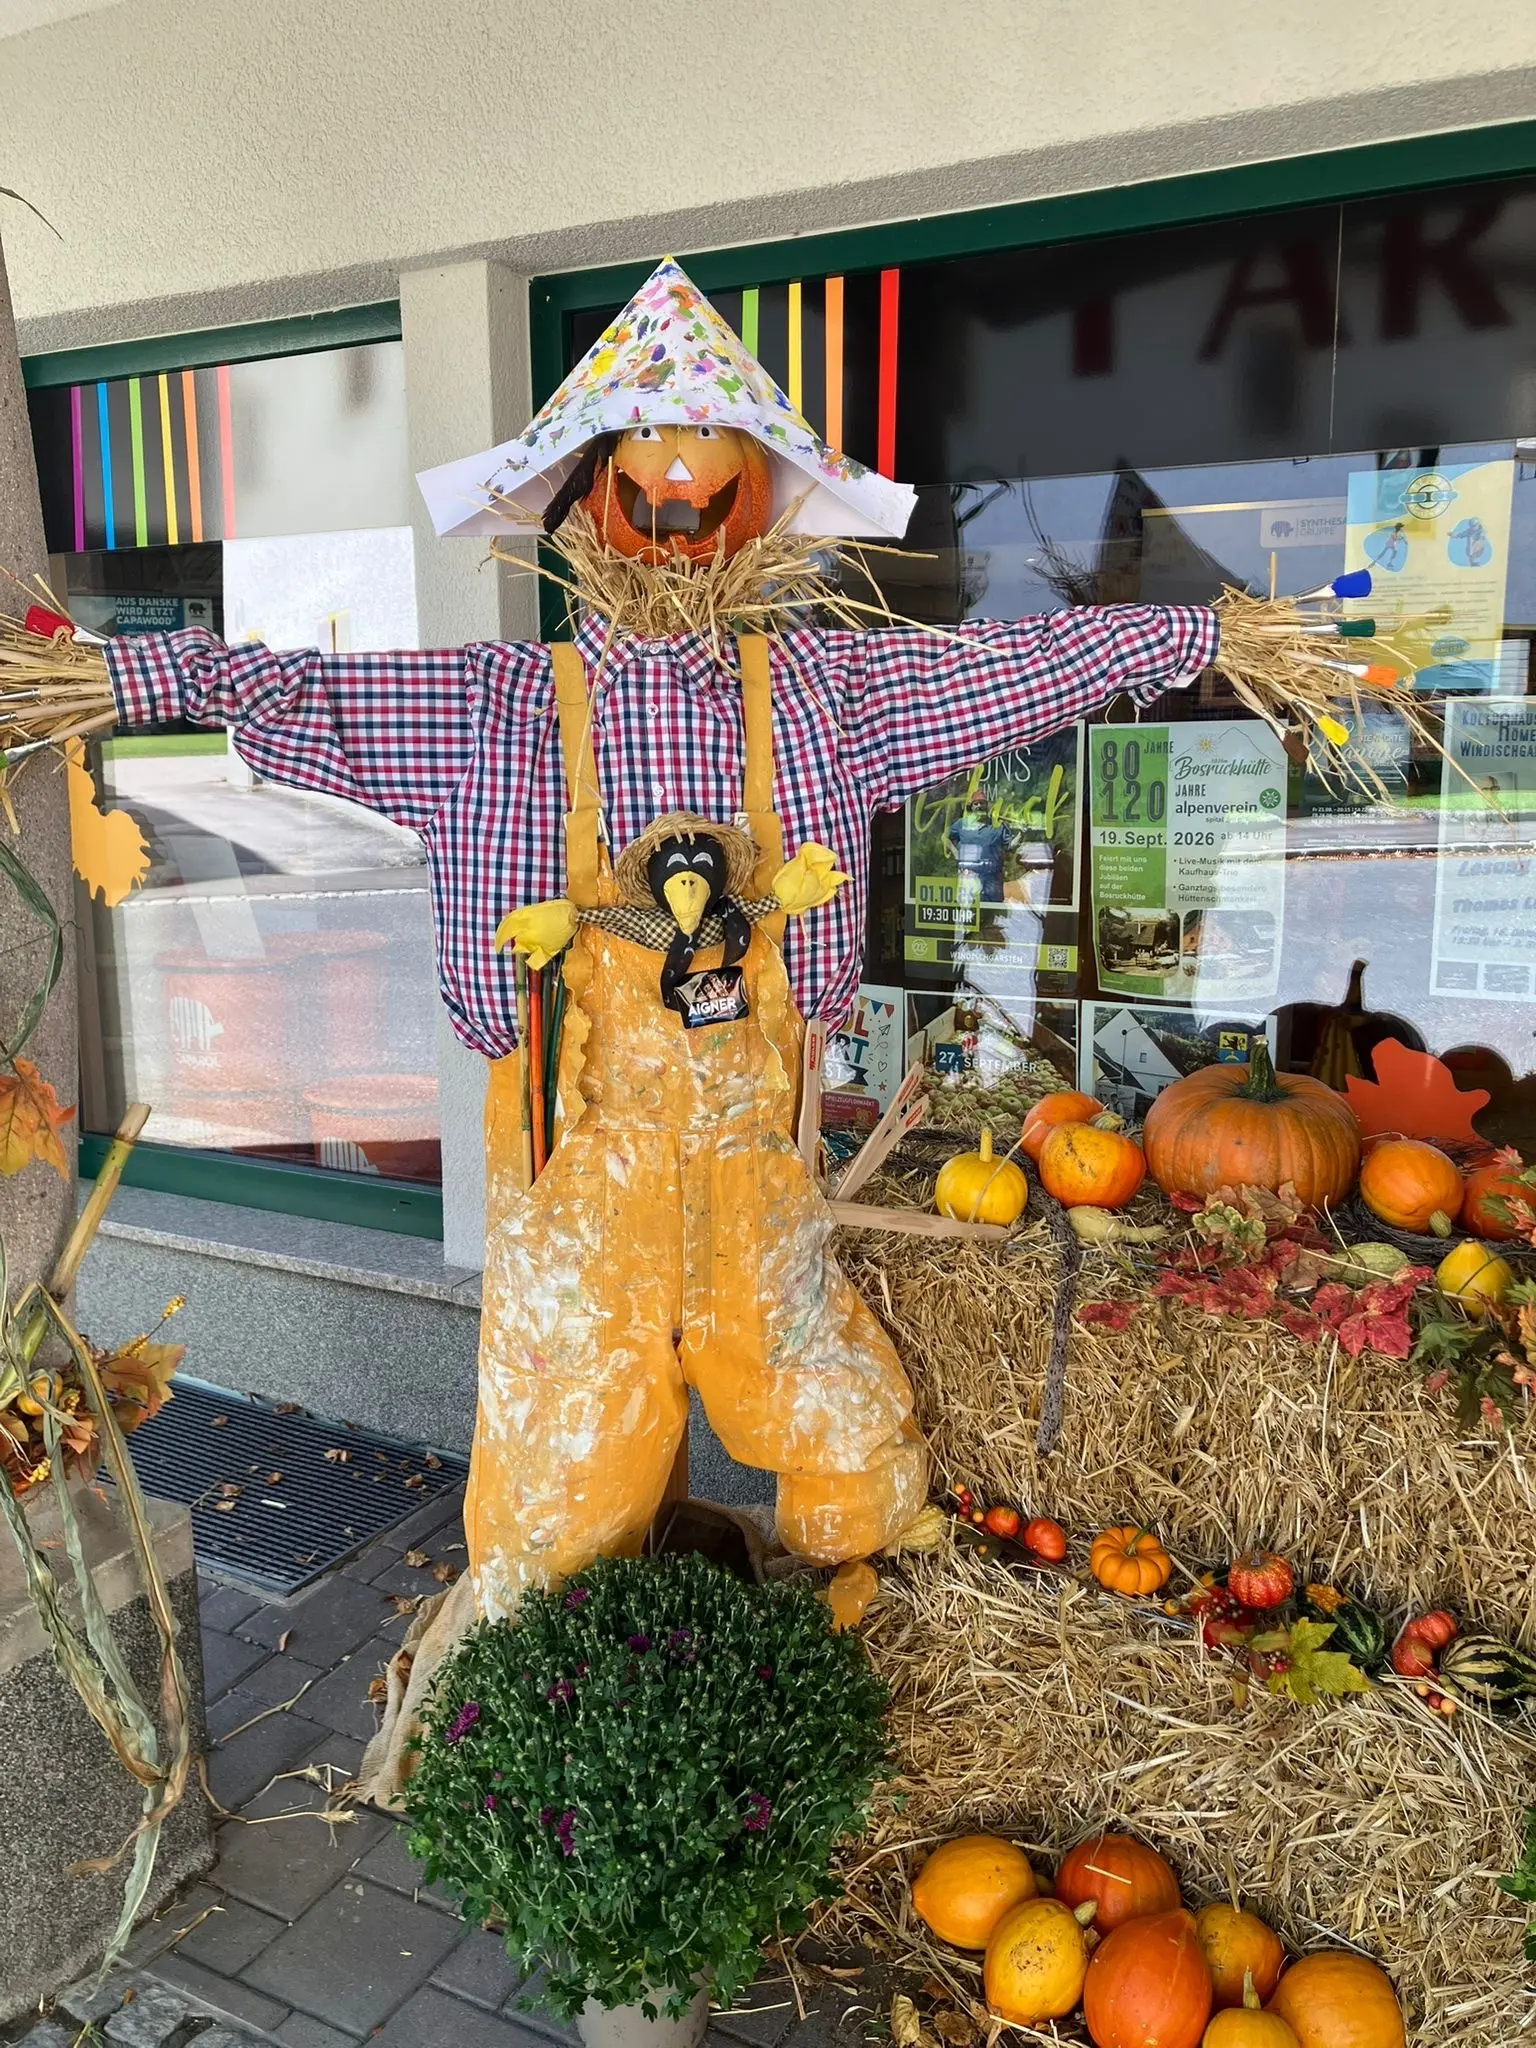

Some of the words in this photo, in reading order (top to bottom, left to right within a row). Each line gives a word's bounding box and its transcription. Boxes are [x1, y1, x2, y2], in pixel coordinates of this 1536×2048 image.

[1299, 528, 1335, 537] GRUPPE
[115, 597, 136, 606] AUS
[138, 597, 178, 607] DANSKE
[115, 606, 144, 616] WIRD
[145, 607, 173, 616] JETZT
[1101, 740, 1141, 782] 80
[1143, 740, 1174, 754] JAHRE
[1174, 755, 1272, 780] Bosruckhütte
[1175, 783, 1206, 797] JAHRE
[1100, 780, 1166, 823] 120
[1175, 800, 1258, 816] alpenverein
[1100, 831, 1121, 845] 19.
[1125, 831, 1168, 848] Sept.
[1174, 831, 1215, 846] 2026
[1220, 831, 1233, 841] ab
[1238, 831, 1250, 841] 14
[1253, 831, 1272, 841] Uhr
[1120, 855, 1132, 863] mit
[1178, 857, 1225, 865] Live-Musik
[1119, 865, 1144, 873] beiden
[922, 907, 949, 921] 19:30
[952, 909, 973, 923] UHR
[949, 950, 1024, 965] WINDISCHGARSTEN
[688, 997, 738, 1017] AIGNER
[939, 1051, 959, 1065] 27.
[963, 1057, 1037, 1073] SEPTEMBER
